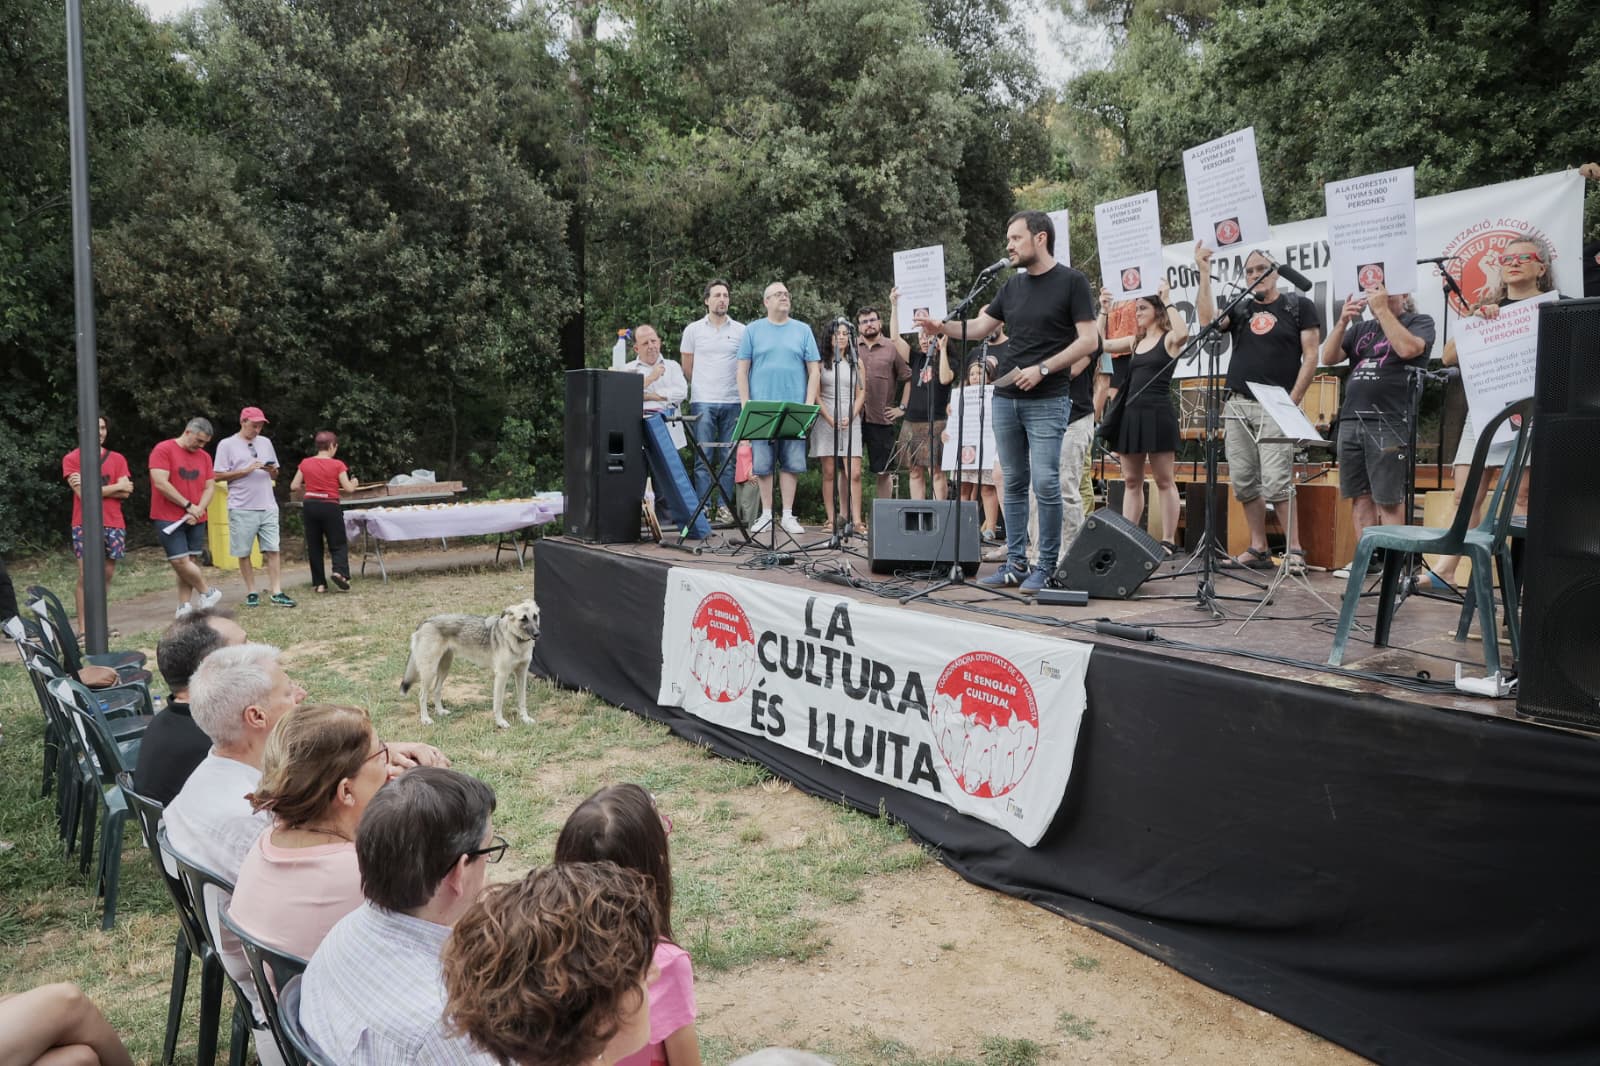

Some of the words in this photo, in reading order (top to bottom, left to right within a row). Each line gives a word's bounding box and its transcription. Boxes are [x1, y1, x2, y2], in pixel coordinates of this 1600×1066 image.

[1205, 139, 1235, 154] FLORESTA
[1200, 153, 1219, 165] VIVIM
[1203, 156, 1234, 171] PERSONES
[1352, 178, 1388, 190] FLORESTA
[1389, 175, 1398, 183] HI
[1345, 191, 1367, 201] VIVIM
[1347, 196, 1385, 209] PERSONES
[1112, 214, 1140, 226] PERSONES
[1432, 220, 1493, 277] OANITZACIÓ,
[1496, 217, 1529, 231] ACCIÓ
[1473, 320, 1484, 329] LA
[1479, 322, 1505, 336] VIVIM
[1484, 325, 1530, 344] PERSONES
[714, 609, 739, 622] SENGLAR
[805, 597, 855, 646] LA
[710, 619, 736, 634] CULTURAL
[758, 631, 929, 722] CULTURA
[963, 671, 972, 681] EL
[974, 674, 1017, 697] SENGLAR
[966, 687, 1009, 709] CULTURAL
[1007, 666, 1017, 678] DE
[1015, 674, 1024, 685] LA
[1022, 683, 1038, 721] FLORESTA
[751, 677, 786, 737] ÉS
[808, 707, 941, 792] LLUITA
